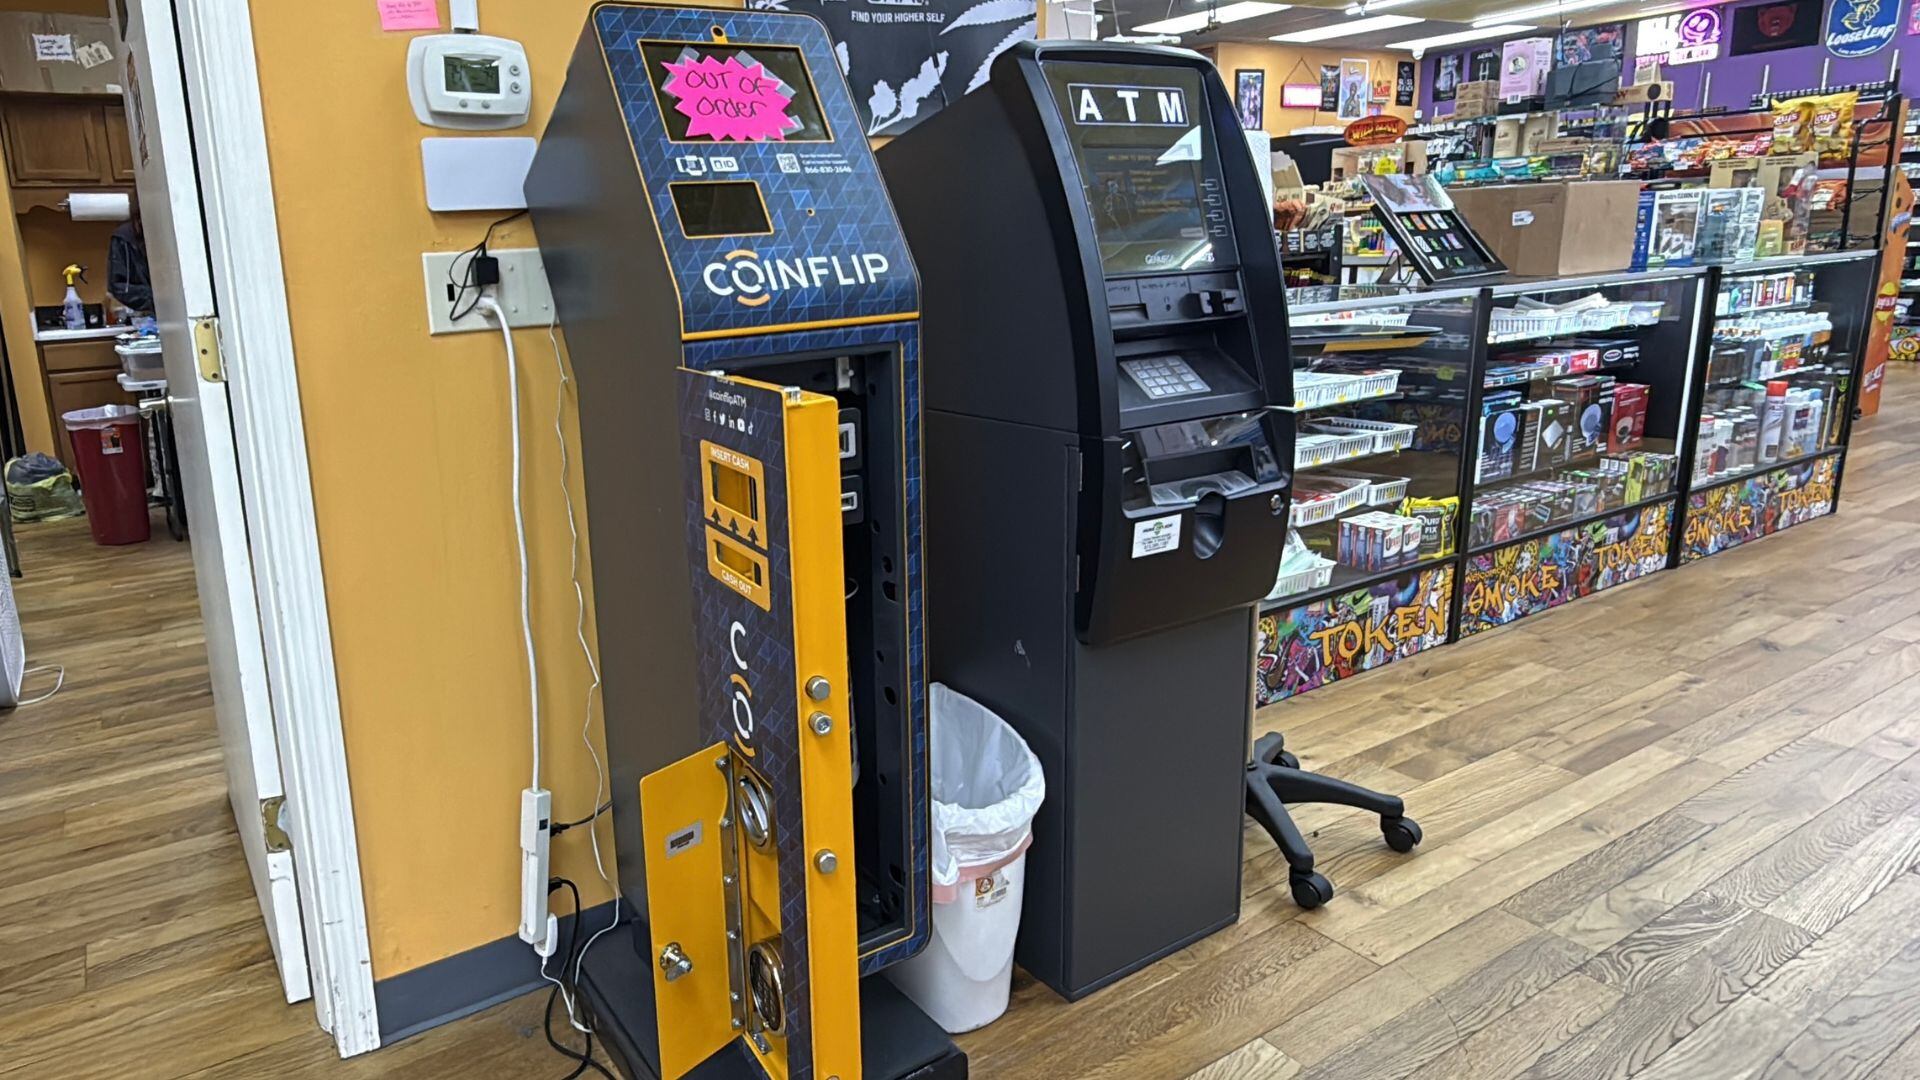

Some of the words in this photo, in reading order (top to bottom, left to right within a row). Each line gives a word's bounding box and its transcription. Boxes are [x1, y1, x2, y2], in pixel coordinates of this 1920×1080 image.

[851, 10, 870, 23] FIND
[871, 12, 894, 24] YOUR
[894, 12, 924, 23] HIGHER
[926, 12, 946, 24] SELF
[685, 70, 733, 90] OUT
[738, 76, 772, 96] OF
[723, 160, 735, 169] ID
[703, 252, 889, 299] COINFLIP
[710, 446, 731, 463] INSERT
[732, 454, 750, 472] CASH
[1685, 505, 1753, 546] SMOKE
[1779, 481, 1833, 512] TOKEN
[1424, 526, 1438, 534] FIX
[721, 569, 738, 587] CASH
[738, 580, 752, 596] OUT
[1468, 564, 1560, 616] SMOKE
[1594, 532, 1668, 572] TOKEN
[1309, 598, 1447, 667] TOKEN
